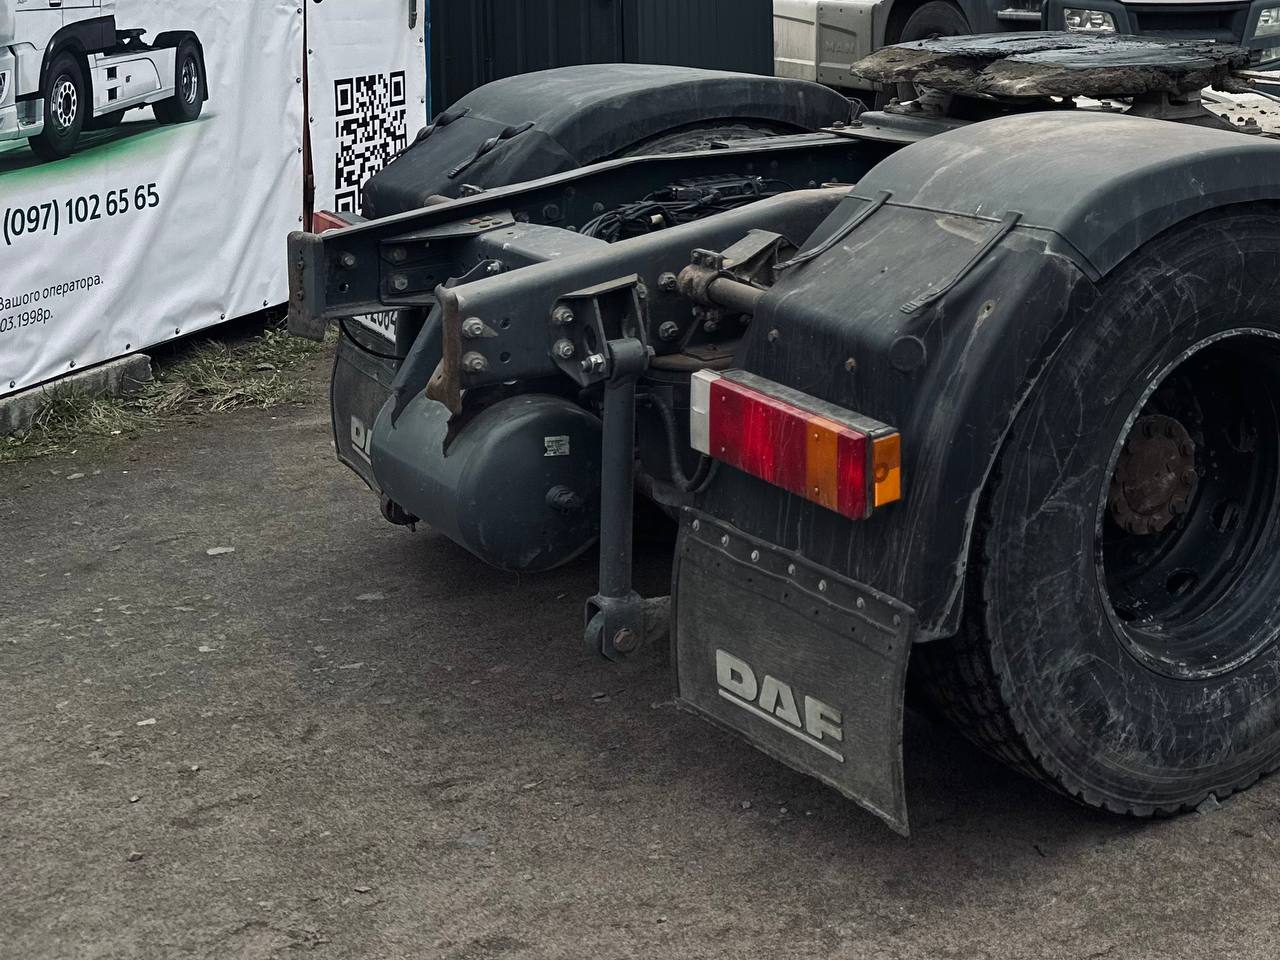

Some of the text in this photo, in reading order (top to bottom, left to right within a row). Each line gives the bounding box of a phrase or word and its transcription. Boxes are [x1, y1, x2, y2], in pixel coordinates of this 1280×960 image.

[3, 183, 160, 246] (097) 102 65 65
[42, 274, 104, 298] оператора.
[716, 649, 843, 741] DAF
